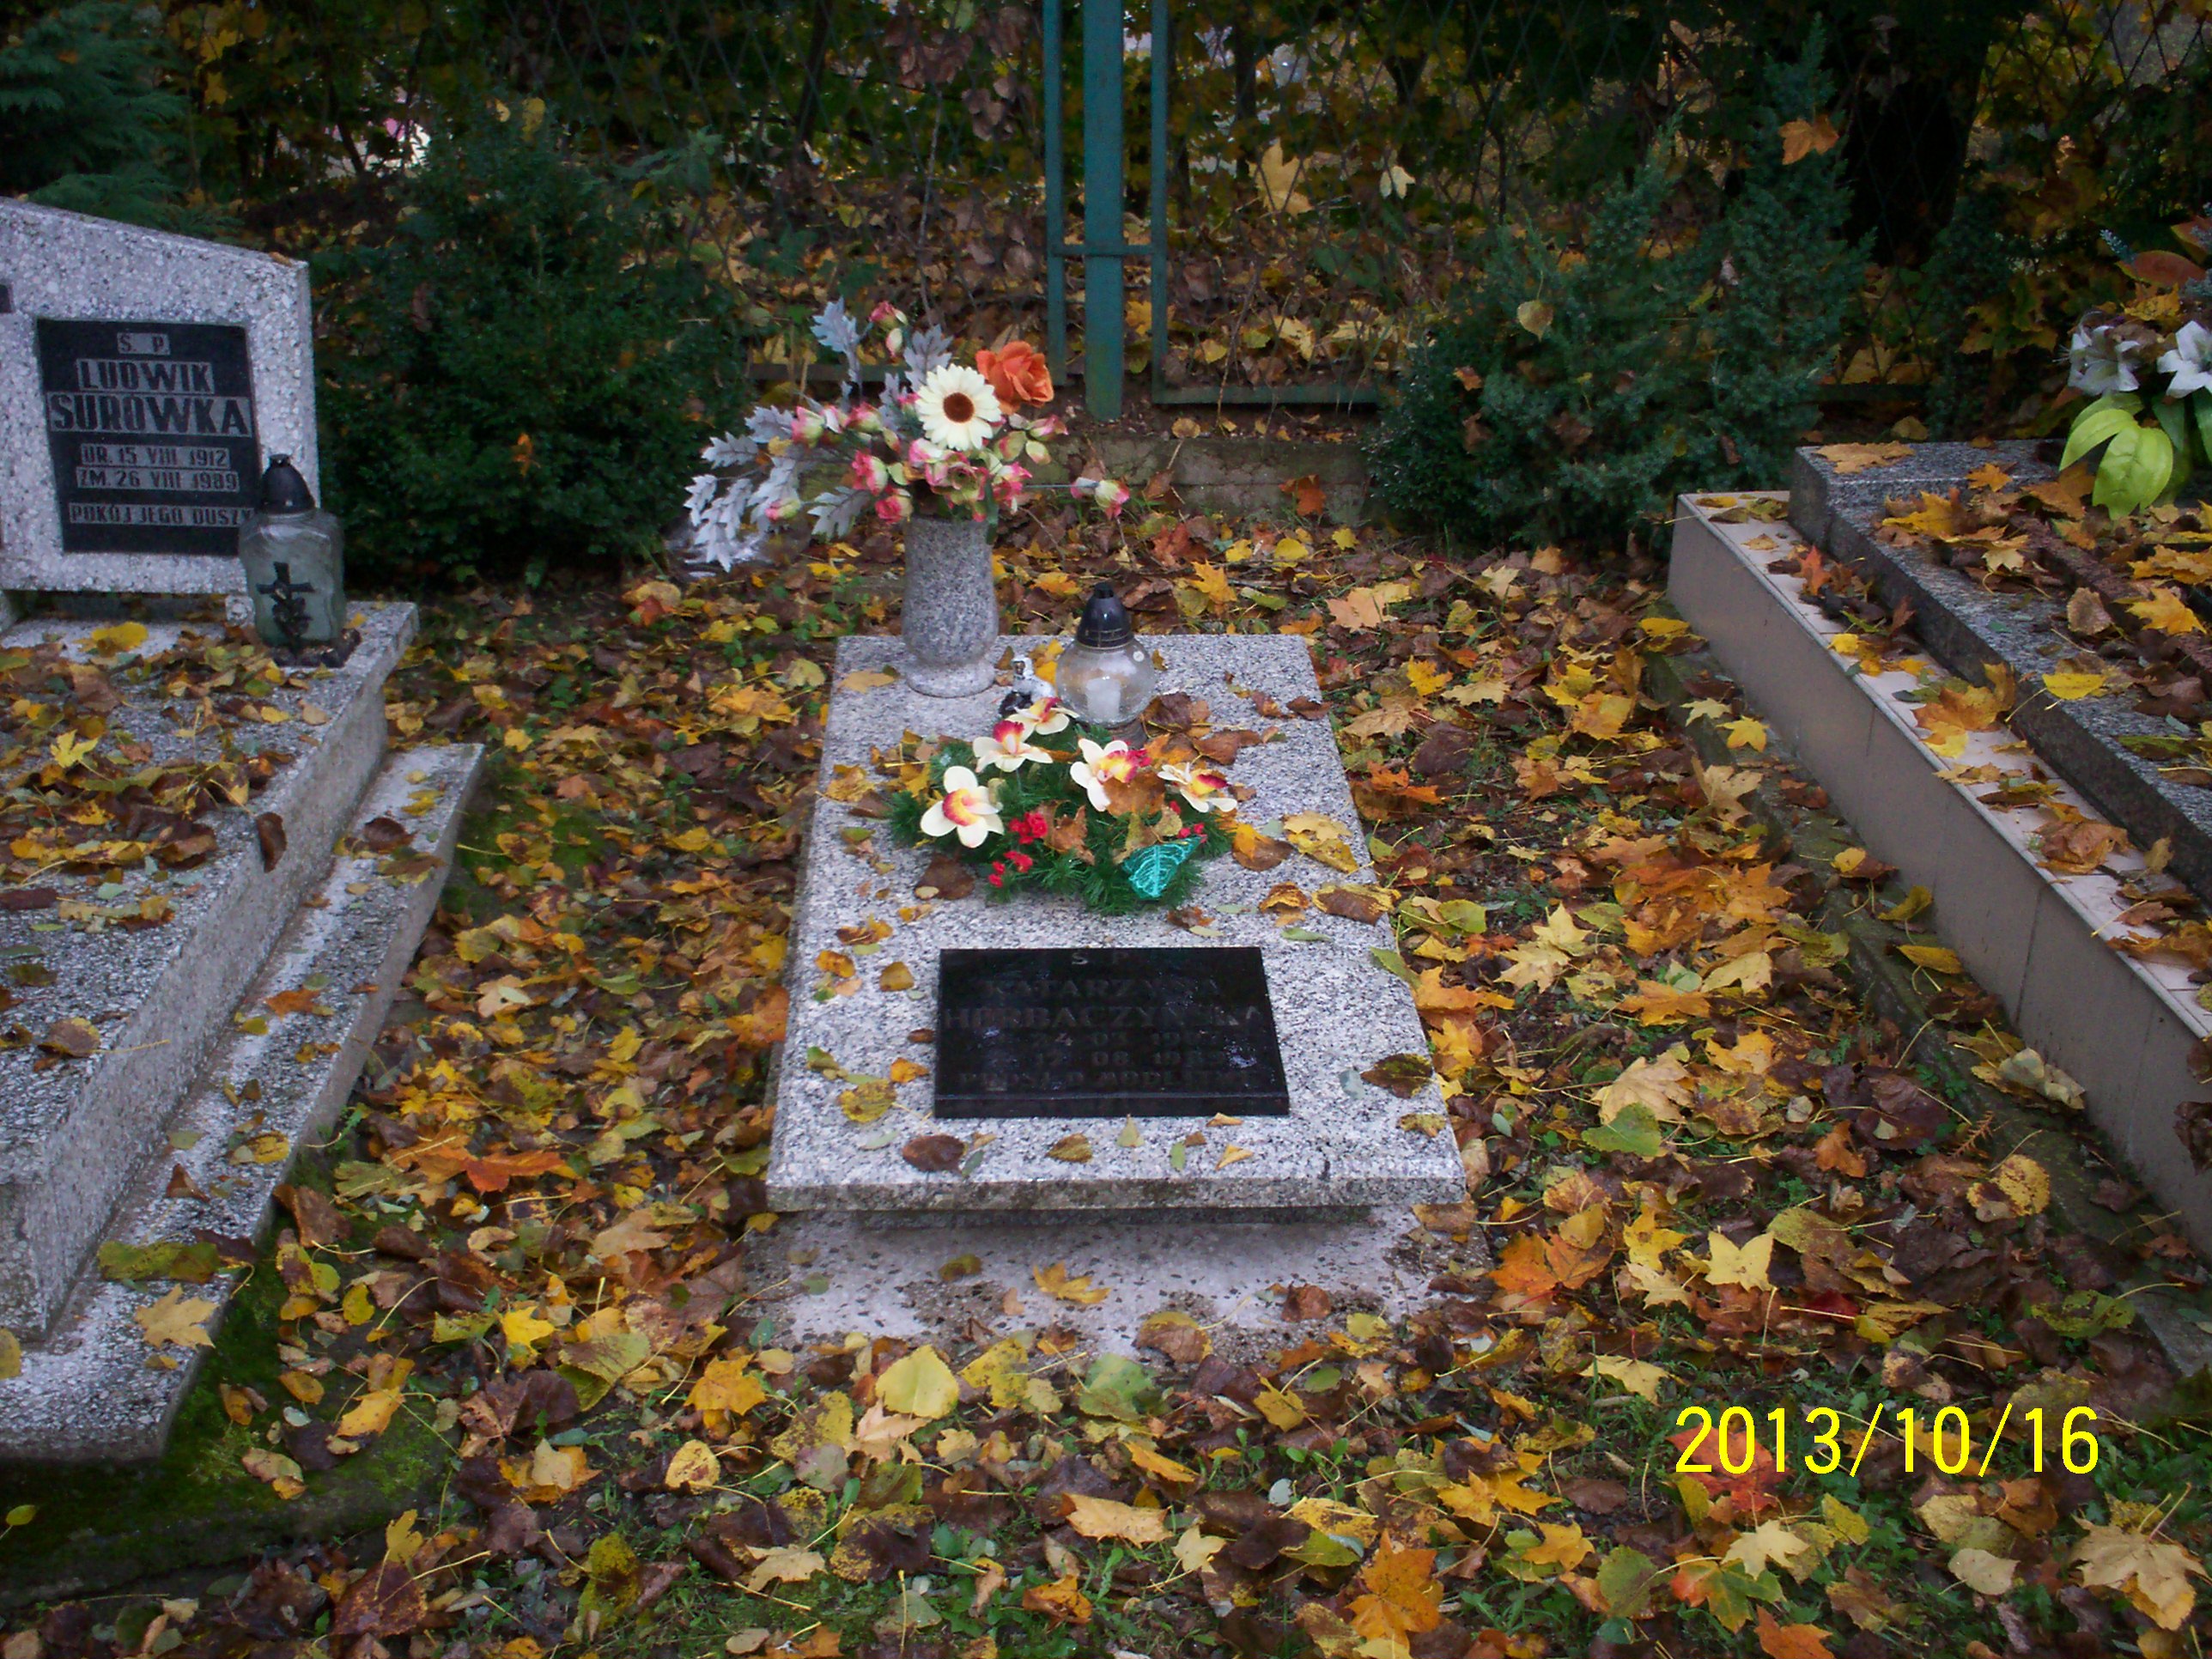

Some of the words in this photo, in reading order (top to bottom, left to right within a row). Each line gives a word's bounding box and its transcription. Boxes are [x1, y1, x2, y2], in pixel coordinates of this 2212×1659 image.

[80, 362, 212, 392] LUDWIK
[118, 447, 137, 464] 15
[189, 449, 228, 466] 1912
[116, 471, 141, 487] 26
